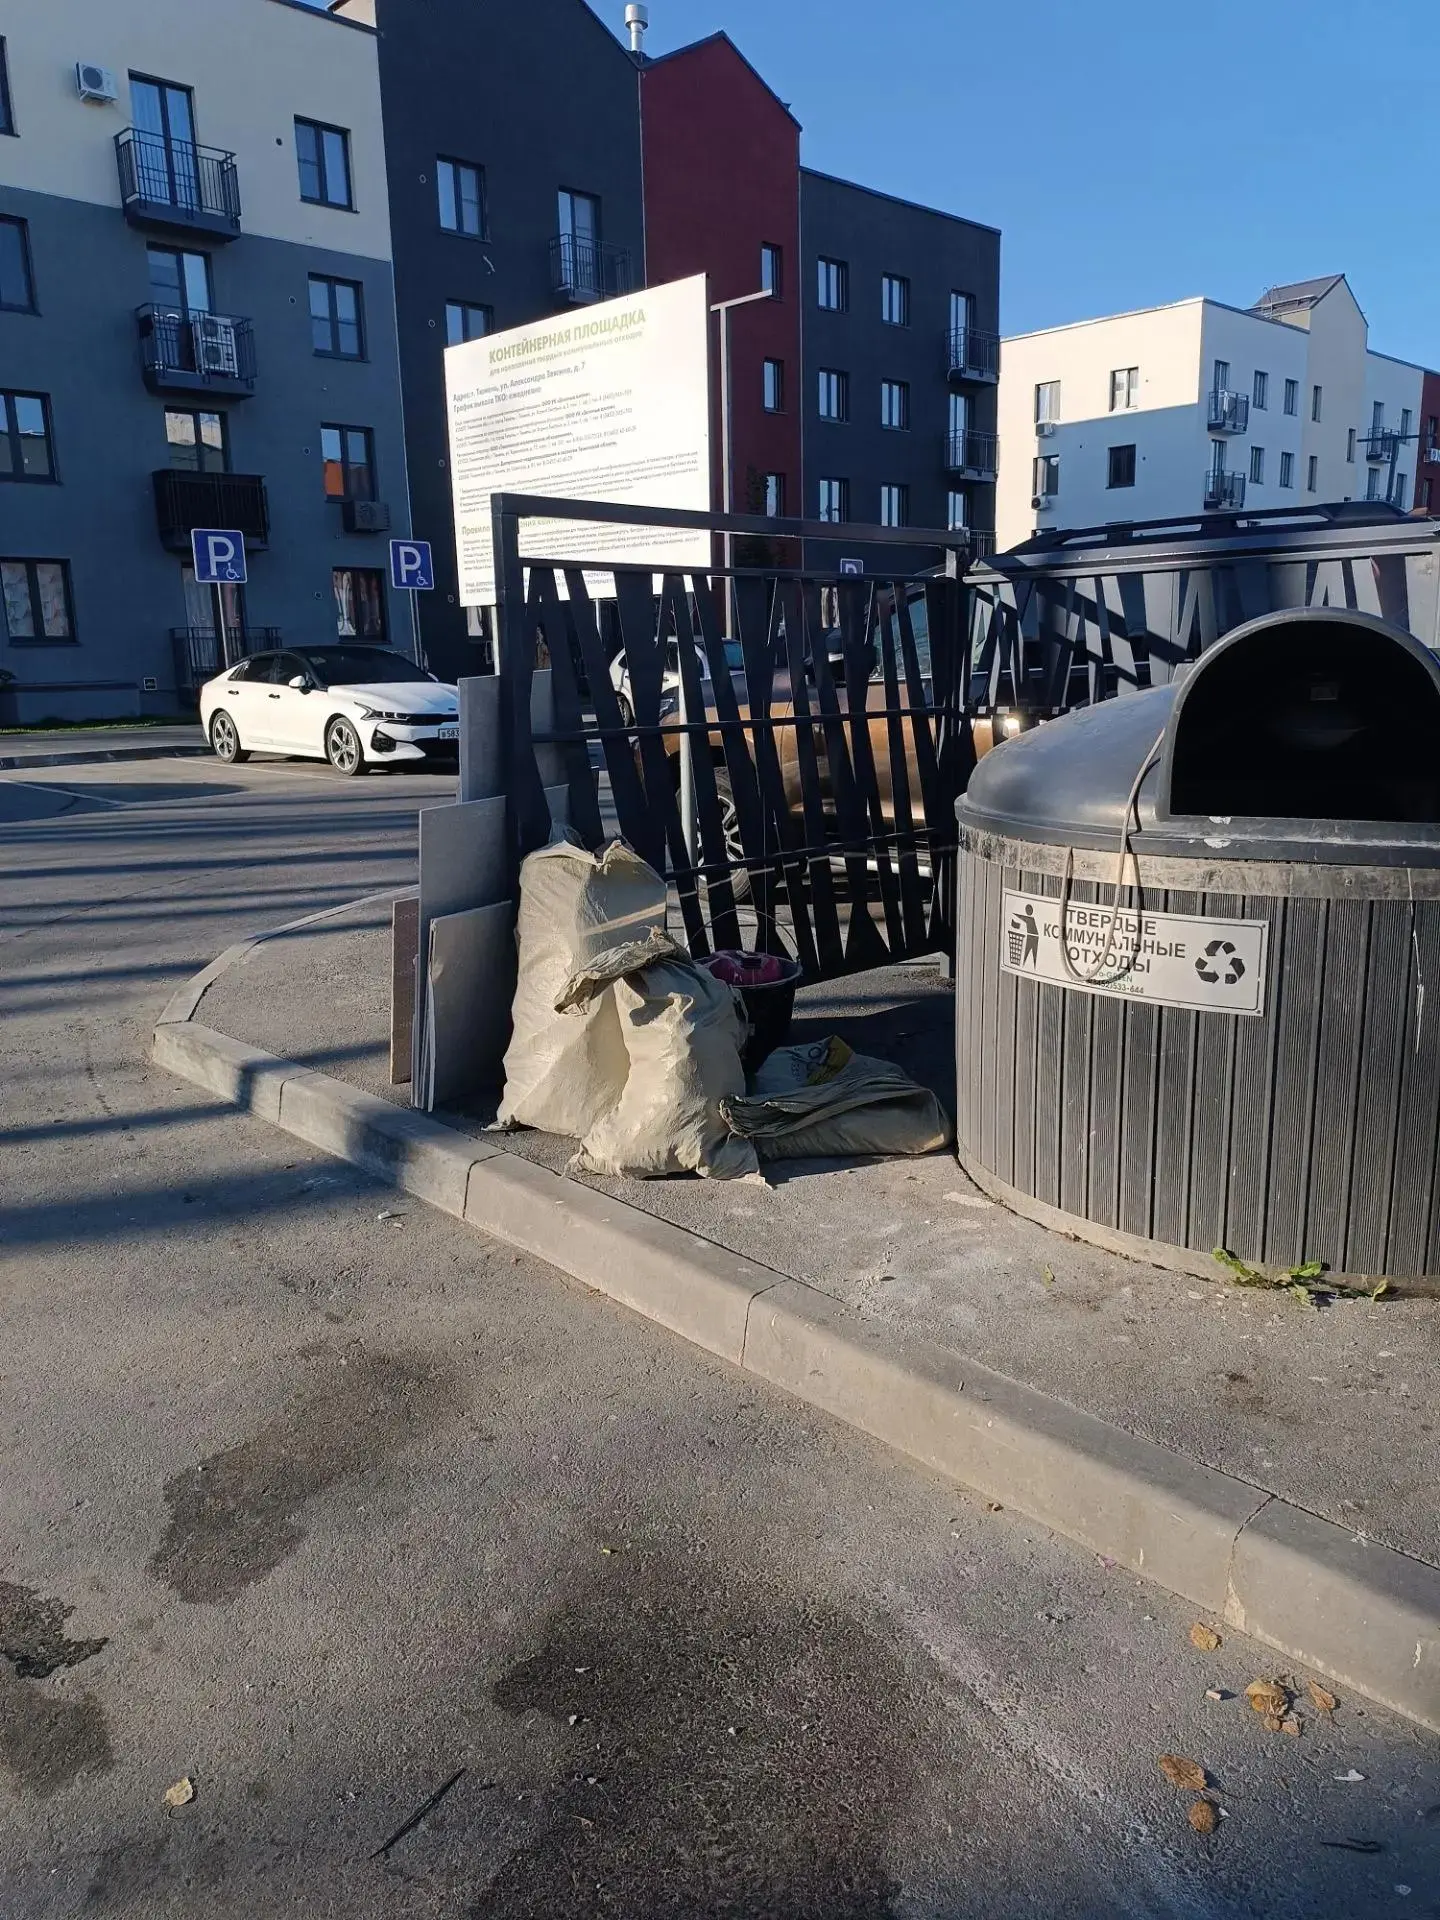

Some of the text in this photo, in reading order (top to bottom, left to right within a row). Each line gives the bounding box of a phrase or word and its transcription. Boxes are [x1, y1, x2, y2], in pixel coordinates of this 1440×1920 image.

[489, 308, 647, 364] КОНТЕЙНЕРНАЯ ПЛОЩАДКА
[207, 536, 235, 576] P
[399, 545, 422, 583] P
[1043, 922, 1187, 959] КОММУНАЛЬНЫЕ
[1065, 909, 1157, 936] ТВЕРДЫЕ
[1067, 945, 1151, 974] ОТХОДЫ
